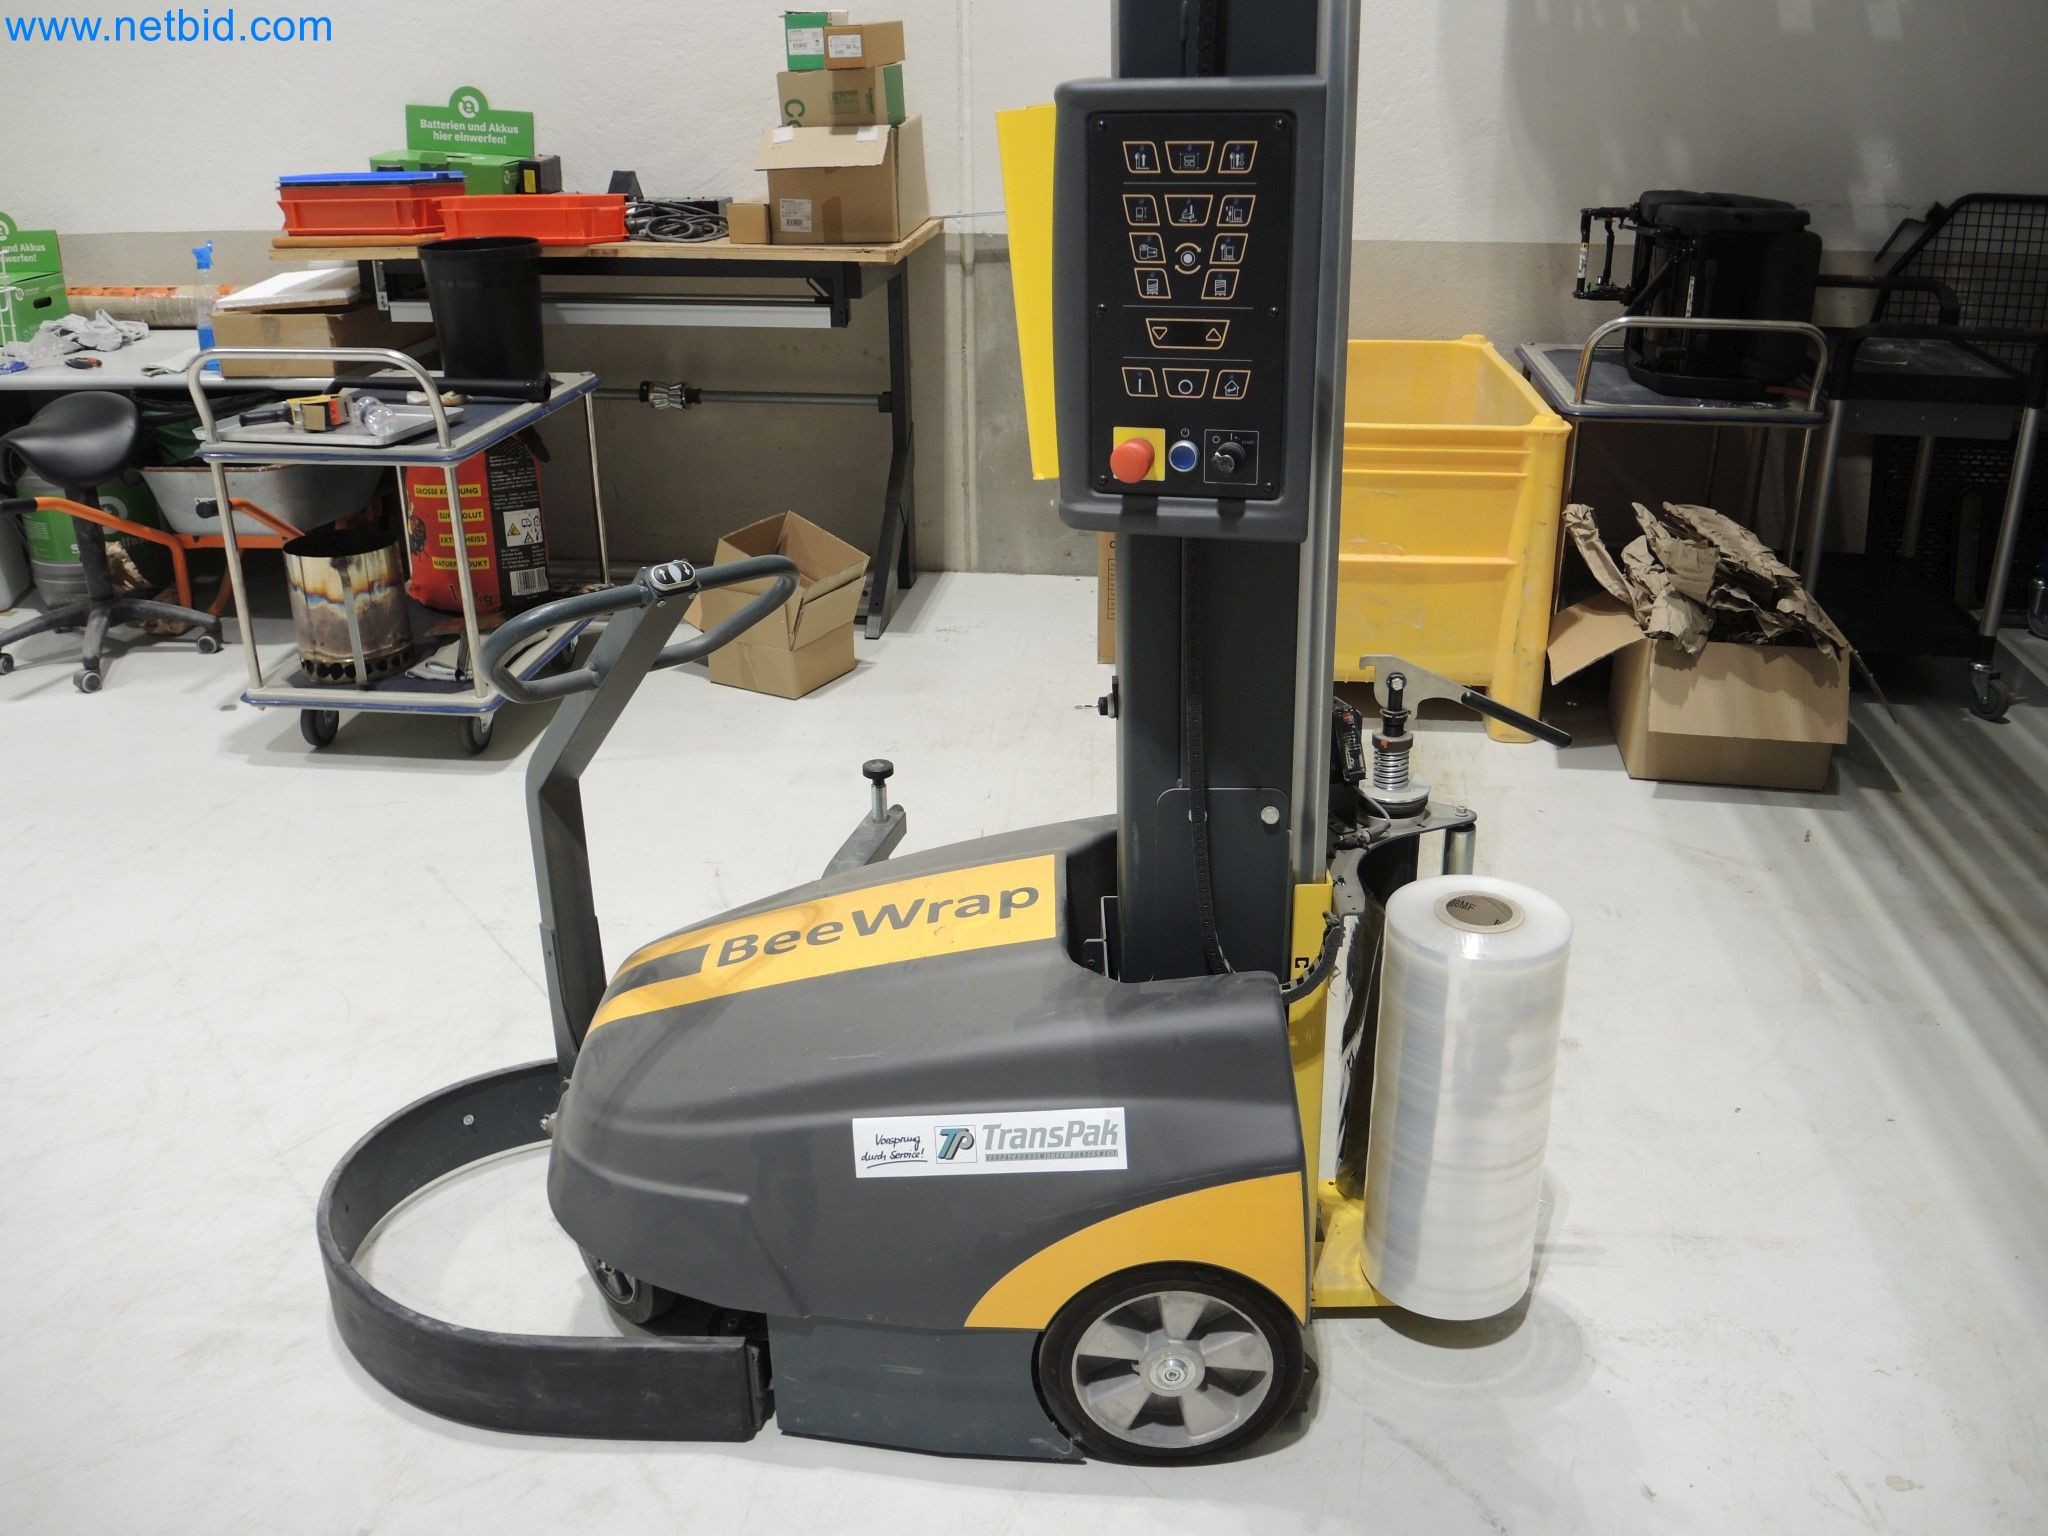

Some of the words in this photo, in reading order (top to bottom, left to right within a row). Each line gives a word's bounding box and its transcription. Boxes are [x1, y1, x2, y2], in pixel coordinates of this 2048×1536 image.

[420, 119, 466, 131] Batterien
[468, 123, 487, 132] und
[489, 123, 519, 134] Akkus
[433, 131, 452, 142] hier
[454, 132, 507, 145] einwerfen!
[20, 243, 46, 252] Akkus
[415, 487, 438, 496] GROSSE
[717, 886, 1039, 968] BeeWrap
[982, 1119, 1119, 1150] TransPak
[875, 1133, 921, 1151] Vorsprung
[861, 1150, 887, 1161] durch
[889, 1148, 925, 1160] Service!
[986, 1151, 1066, 1161] VERPACKUNGSMITTEL
[1069, 1149, 1118, 1159] BUNDESWEIT
